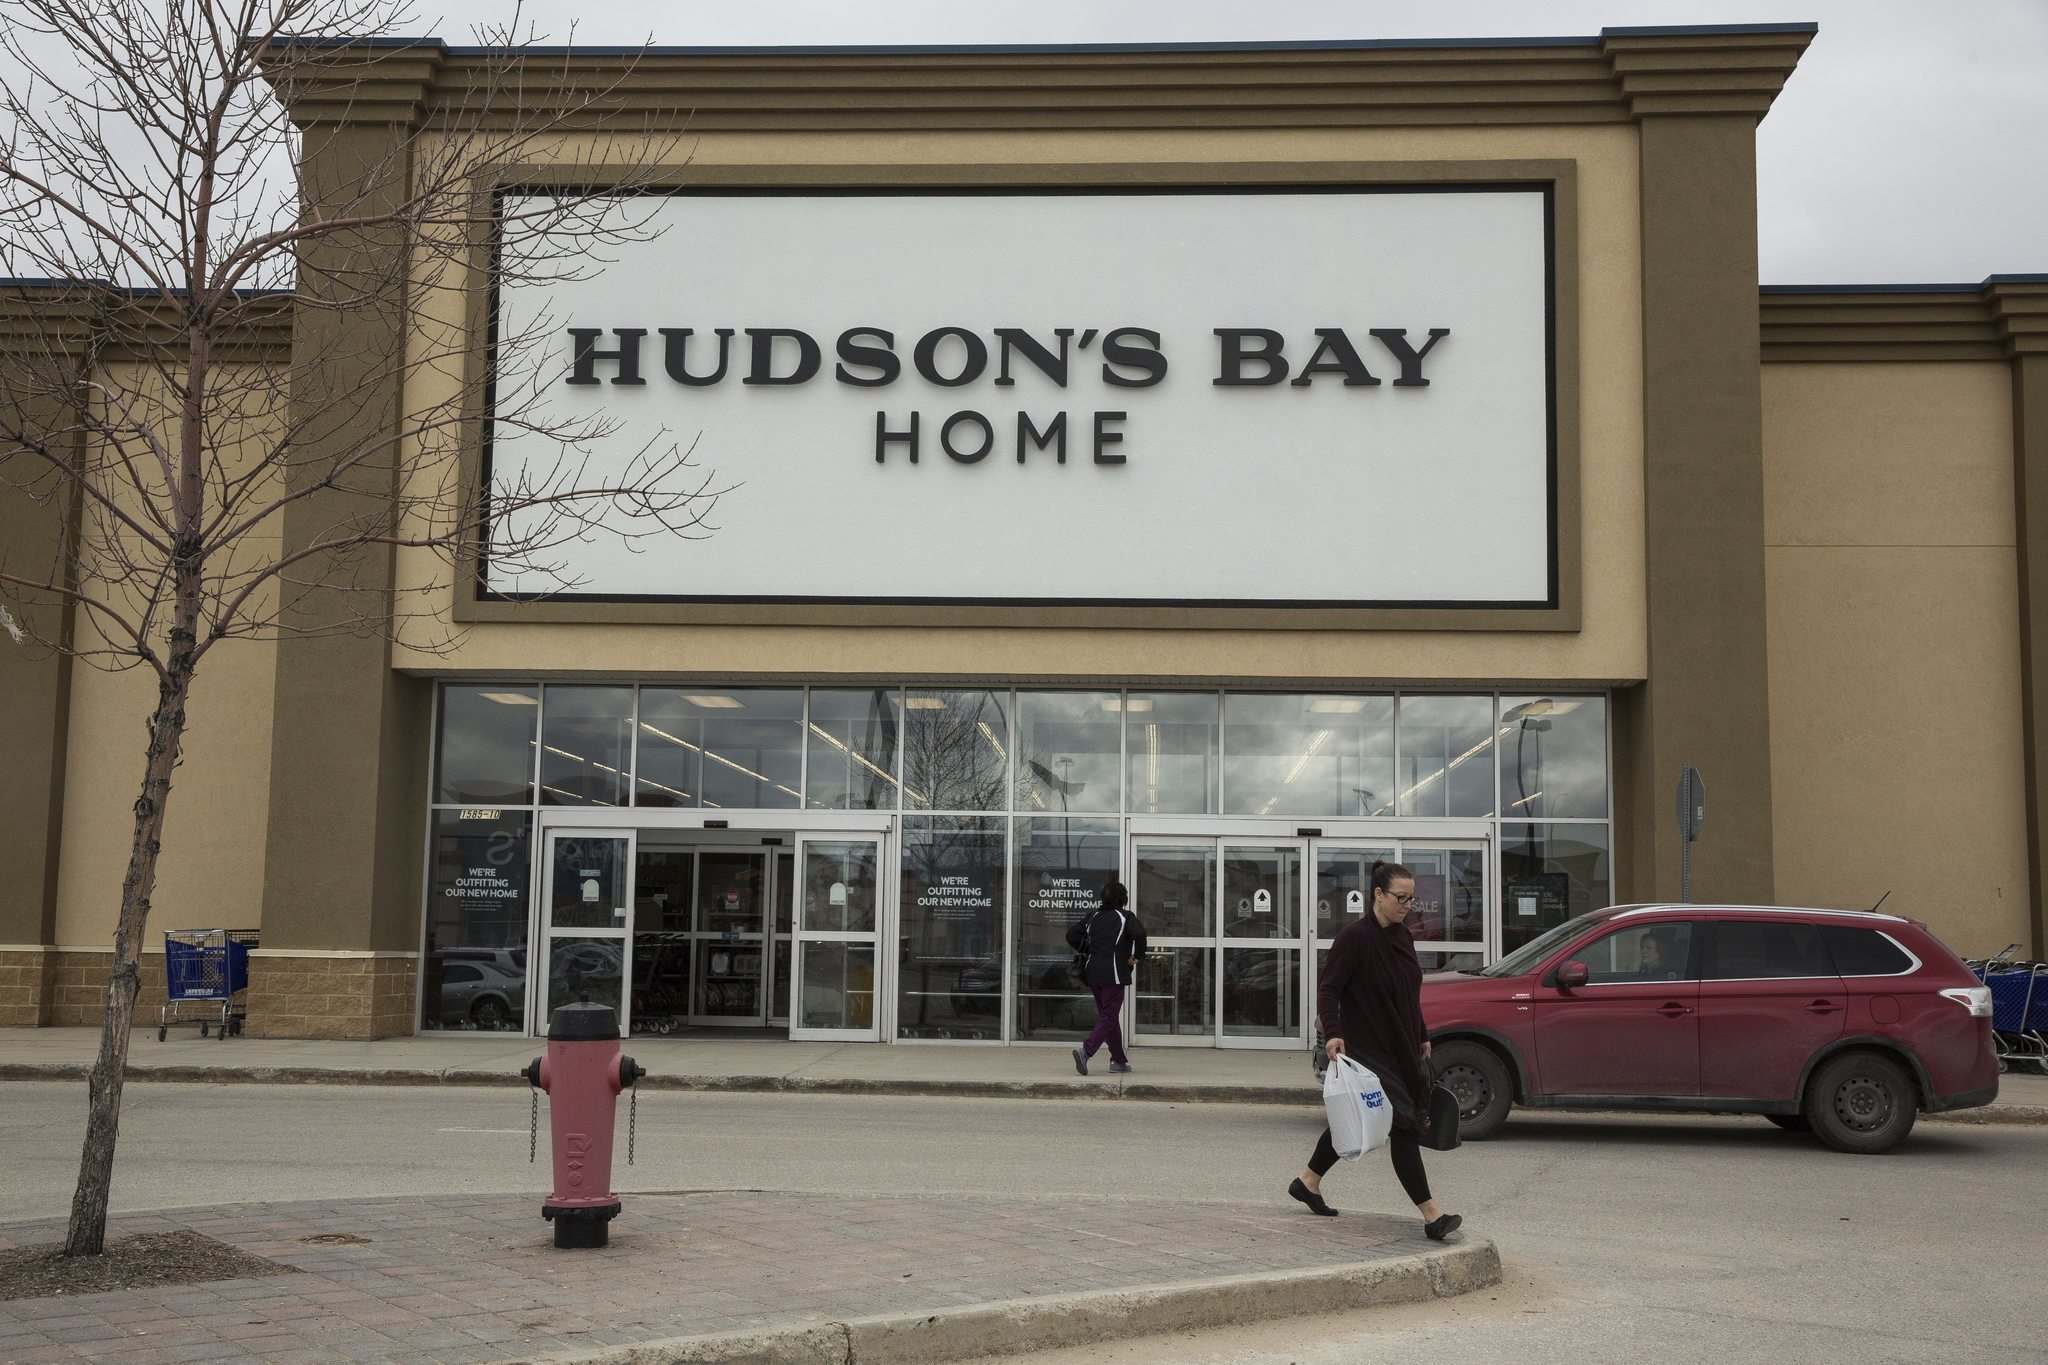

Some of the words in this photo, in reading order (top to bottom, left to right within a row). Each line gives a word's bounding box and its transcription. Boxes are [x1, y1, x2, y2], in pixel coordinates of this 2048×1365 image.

[565, 327, 1168, 387] HUDSON'S
[1213, 328, 1450, 387] BAY
[875, 410, 1127, 464] HOME
[468, 868, 497, 877] WE'RE
[455, 878, 509, 887] OUTFITTING
[940, 876, 969, 886] WE'RE
[1052, 879, 1081, 888] WE'RE
[445, 888, 467, 897] OUR
[467, 889, 489, 898] NEW
[489, 889, 519, 898] HOME
[927, 887, 982, 896] OUTFITTING
[1039, 889, 1094, 898] OUTFITTING
[917, 897, 939, 906] OUR
[940, 898, 962, 906] NEW
[962, 898, 992, 907] HOME
[1028, 899, 1050, 908] OUR
[1050, 900, 1073, 909] NEW
